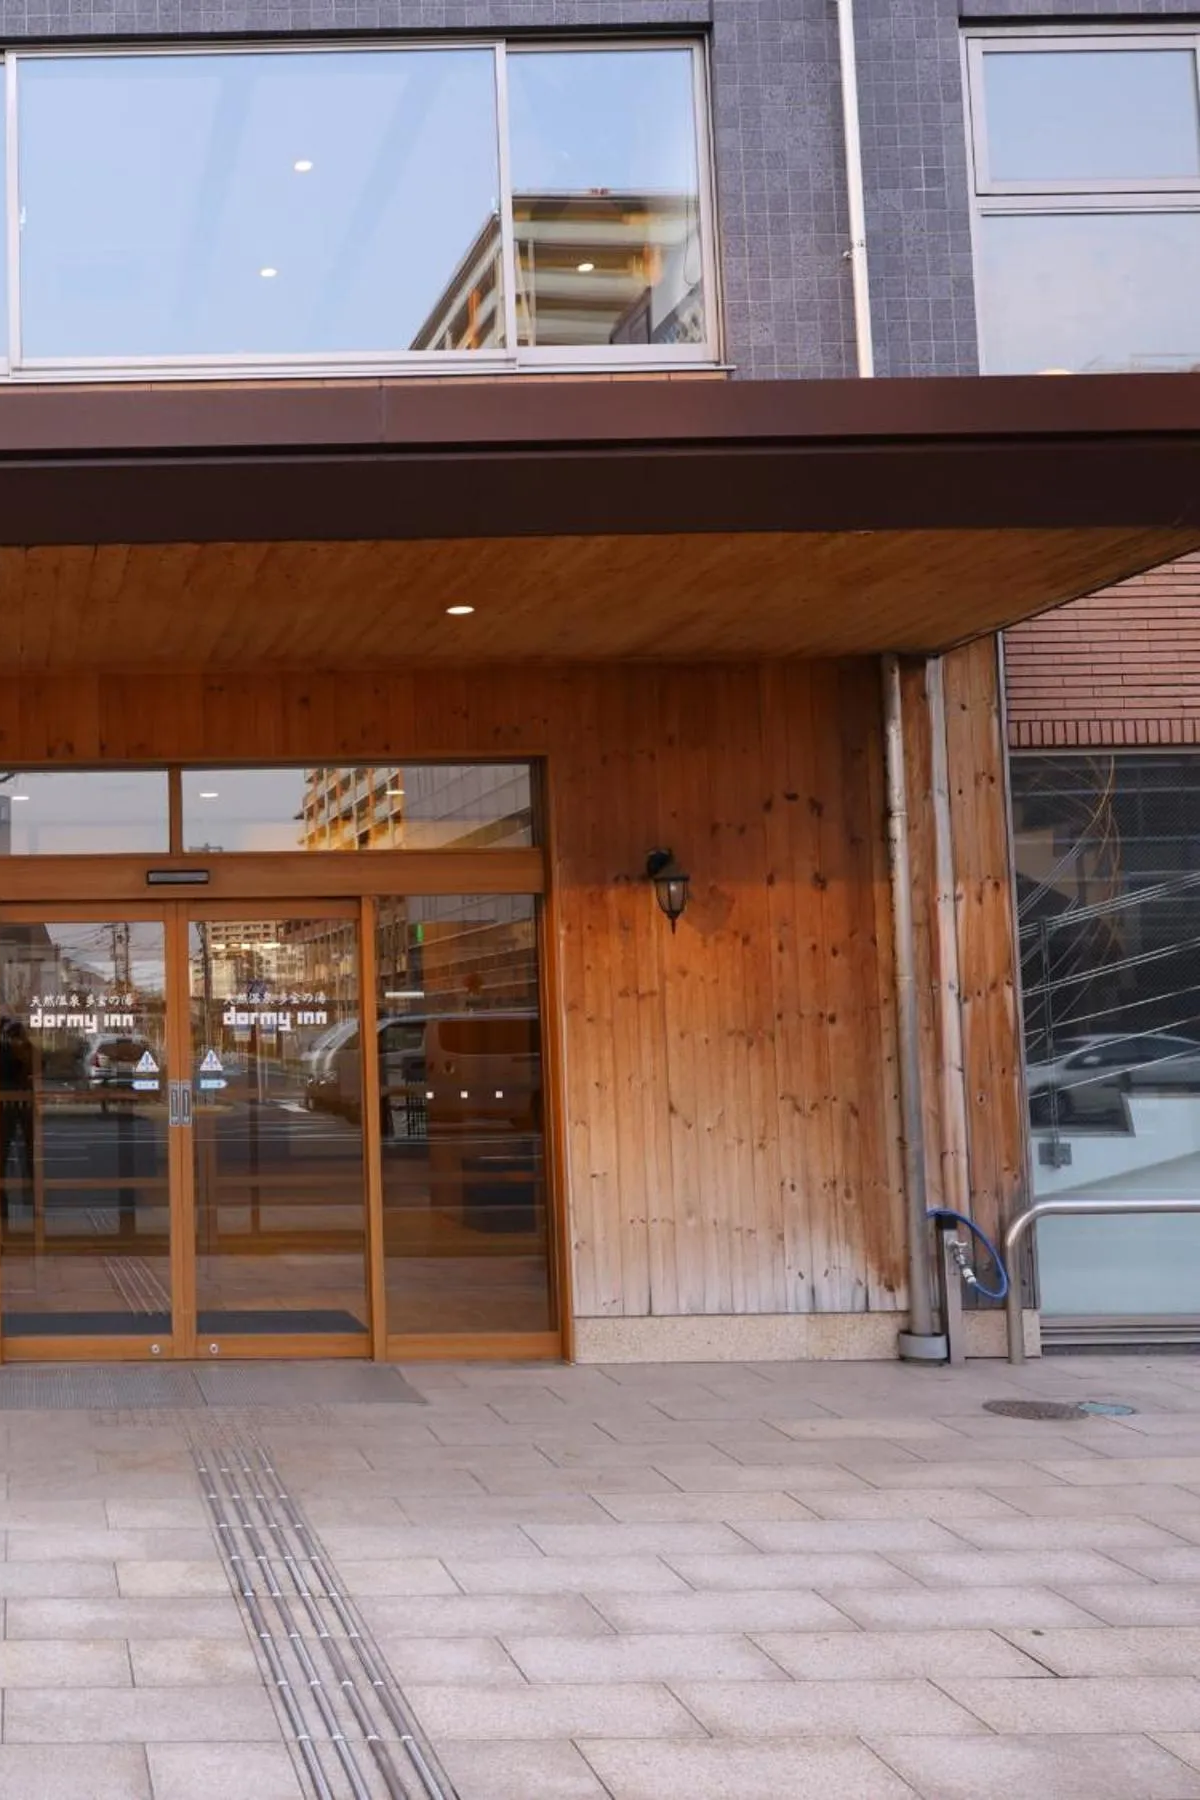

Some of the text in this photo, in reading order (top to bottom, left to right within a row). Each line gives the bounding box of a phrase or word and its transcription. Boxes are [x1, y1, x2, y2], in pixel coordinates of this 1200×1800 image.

[30, 1008, 134, 1034] dormy inn
[223, 1006, 328, 1031] dormy inn
